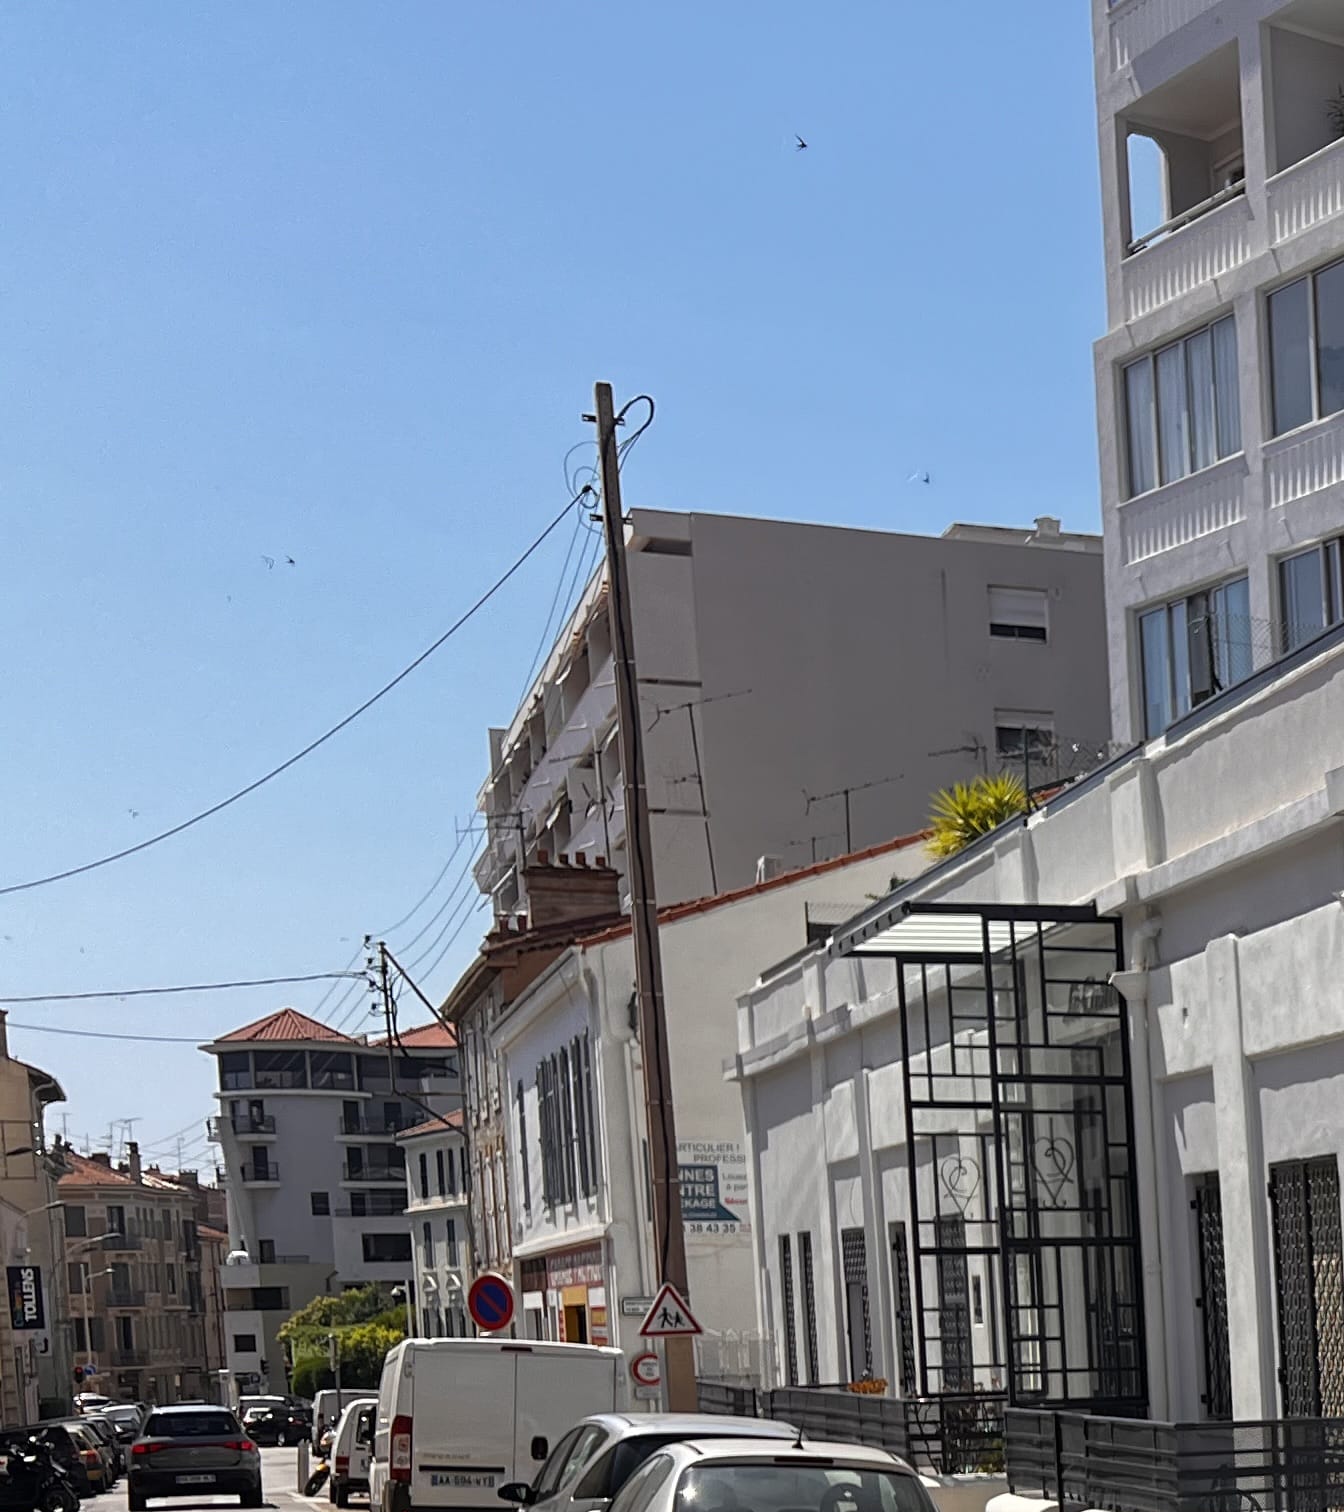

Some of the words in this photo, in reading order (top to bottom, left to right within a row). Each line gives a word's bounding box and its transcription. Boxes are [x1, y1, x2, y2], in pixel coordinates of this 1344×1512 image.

[678, 1143, 734, 1153] RTICULIER
[694, 1154, 745, 1163] PROFESSI
[679, 1168, 714, 1182] NNES
[680, 1184, 715, 1197] NTRE
[681, 1199, 716, 1209] KAGE
[20, 1268, 38, 1322] TOLLENS
